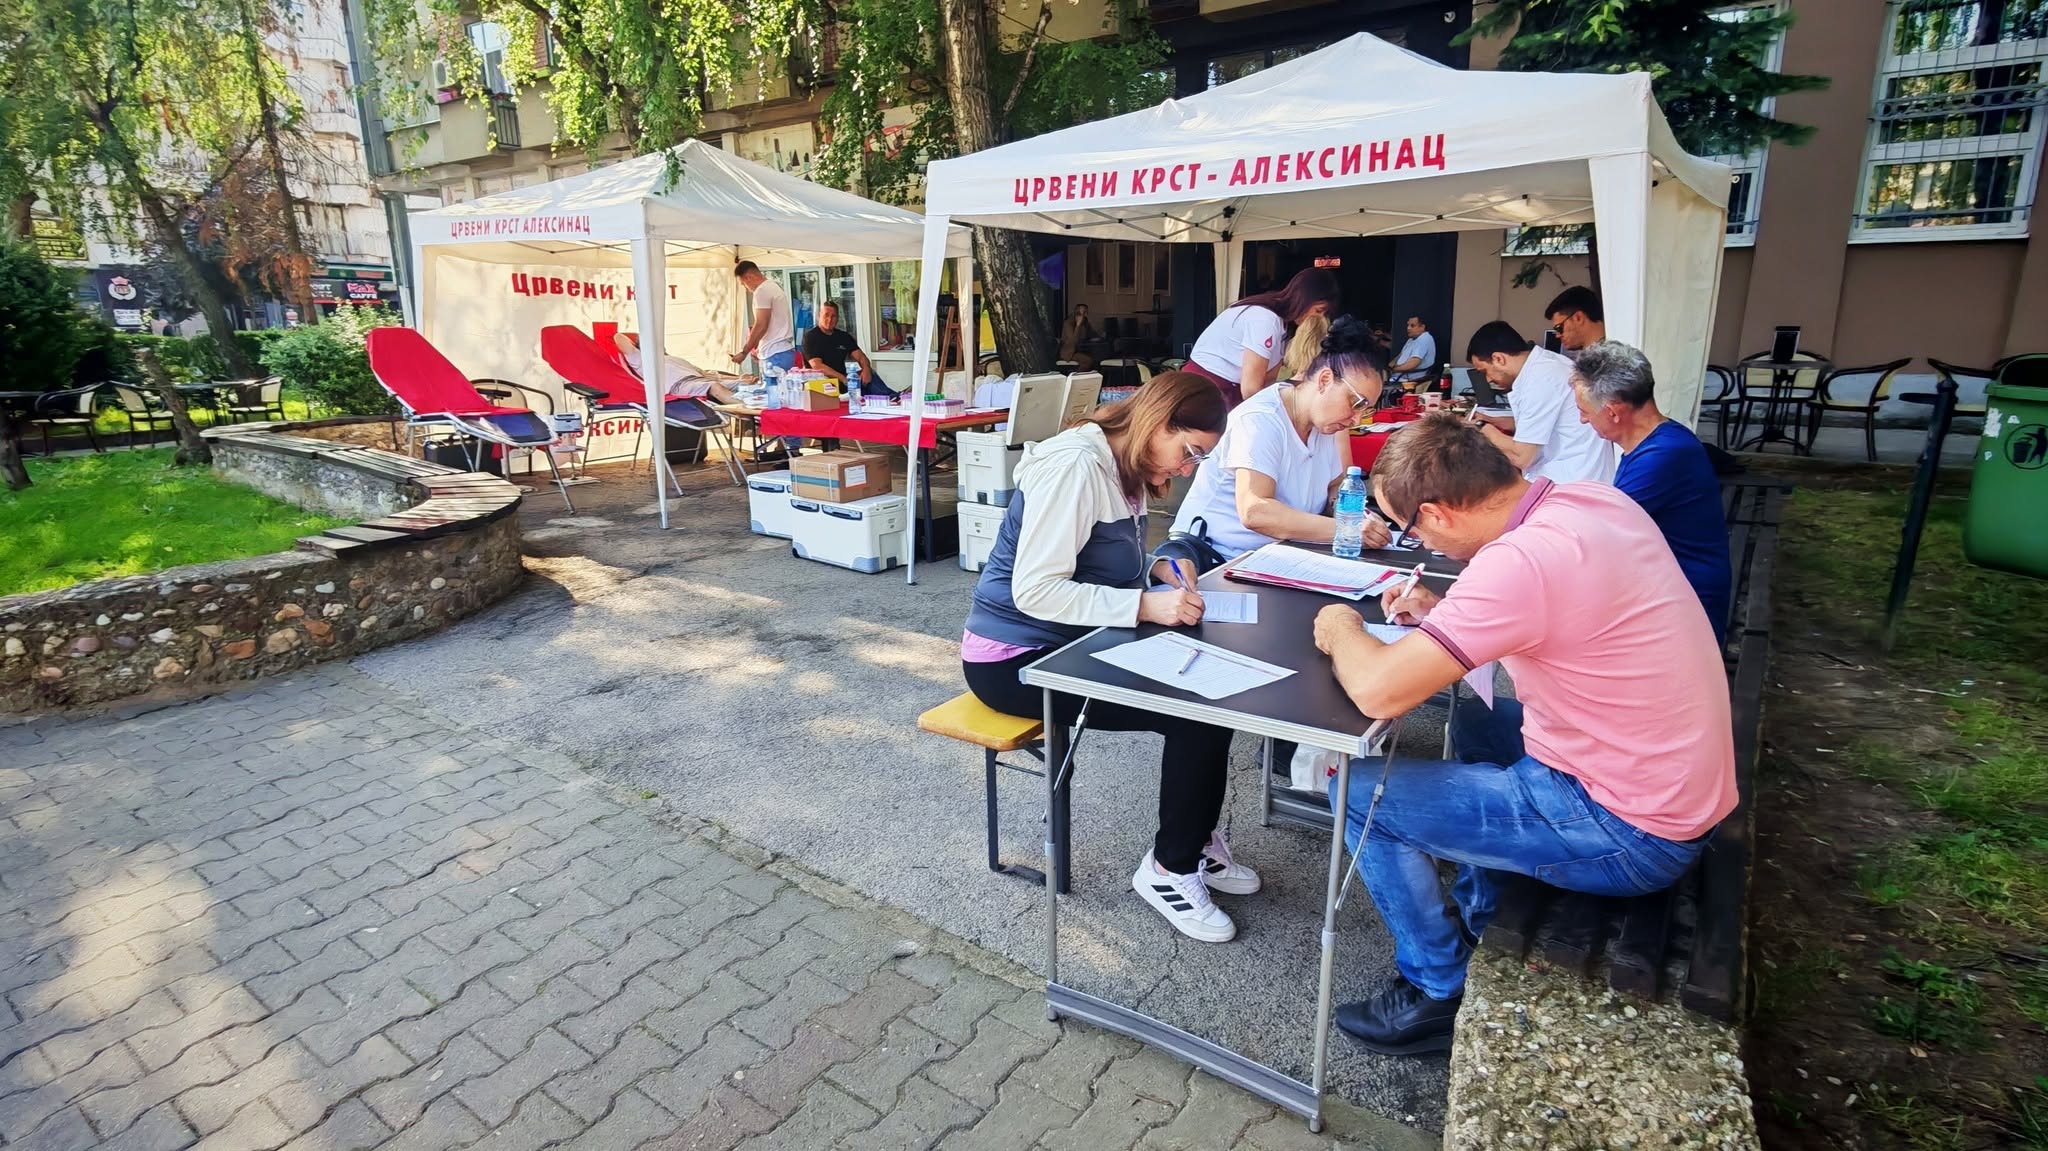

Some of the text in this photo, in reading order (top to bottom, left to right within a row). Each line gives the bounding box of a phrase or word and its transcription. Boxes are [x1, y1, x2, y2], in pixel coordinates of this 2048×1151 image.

[1014, 170, 1118, 207] ЦРВЕНИ
[1229, 133, 1446, 187] АЛЕКСИНАЦ
[451, 215, 591, 239] ЦРВЕНИ КРСТ АЛЕКСИНАЦ
